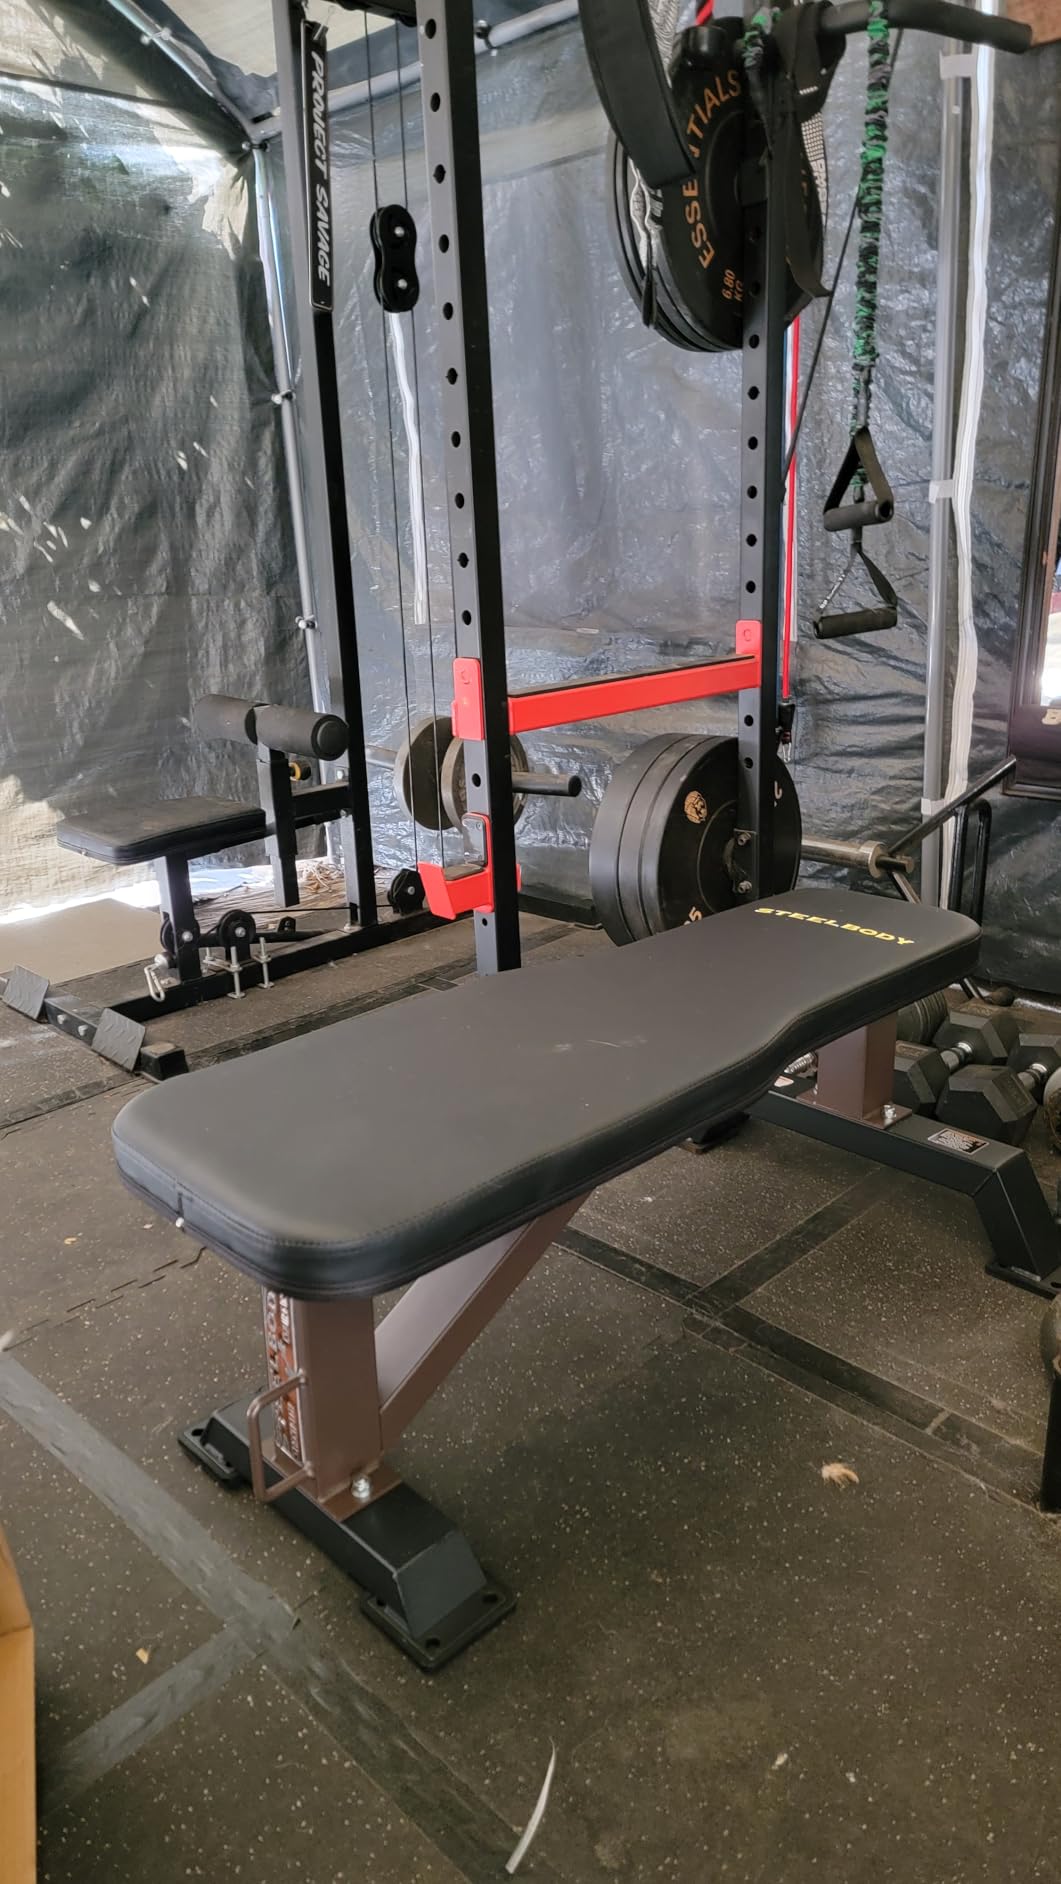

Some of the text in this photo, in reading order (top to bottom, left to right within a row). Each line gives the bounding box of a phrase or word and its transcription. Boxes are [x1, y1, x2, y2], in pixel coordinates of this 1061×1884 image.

[311, 50, 330, 287] PROJECT SAVAGE
[683, 69, 740, 269] ESSETIALS
[721, 269, 735, 300] 6.80
[754, 907, 915, 945] STEELBODY
